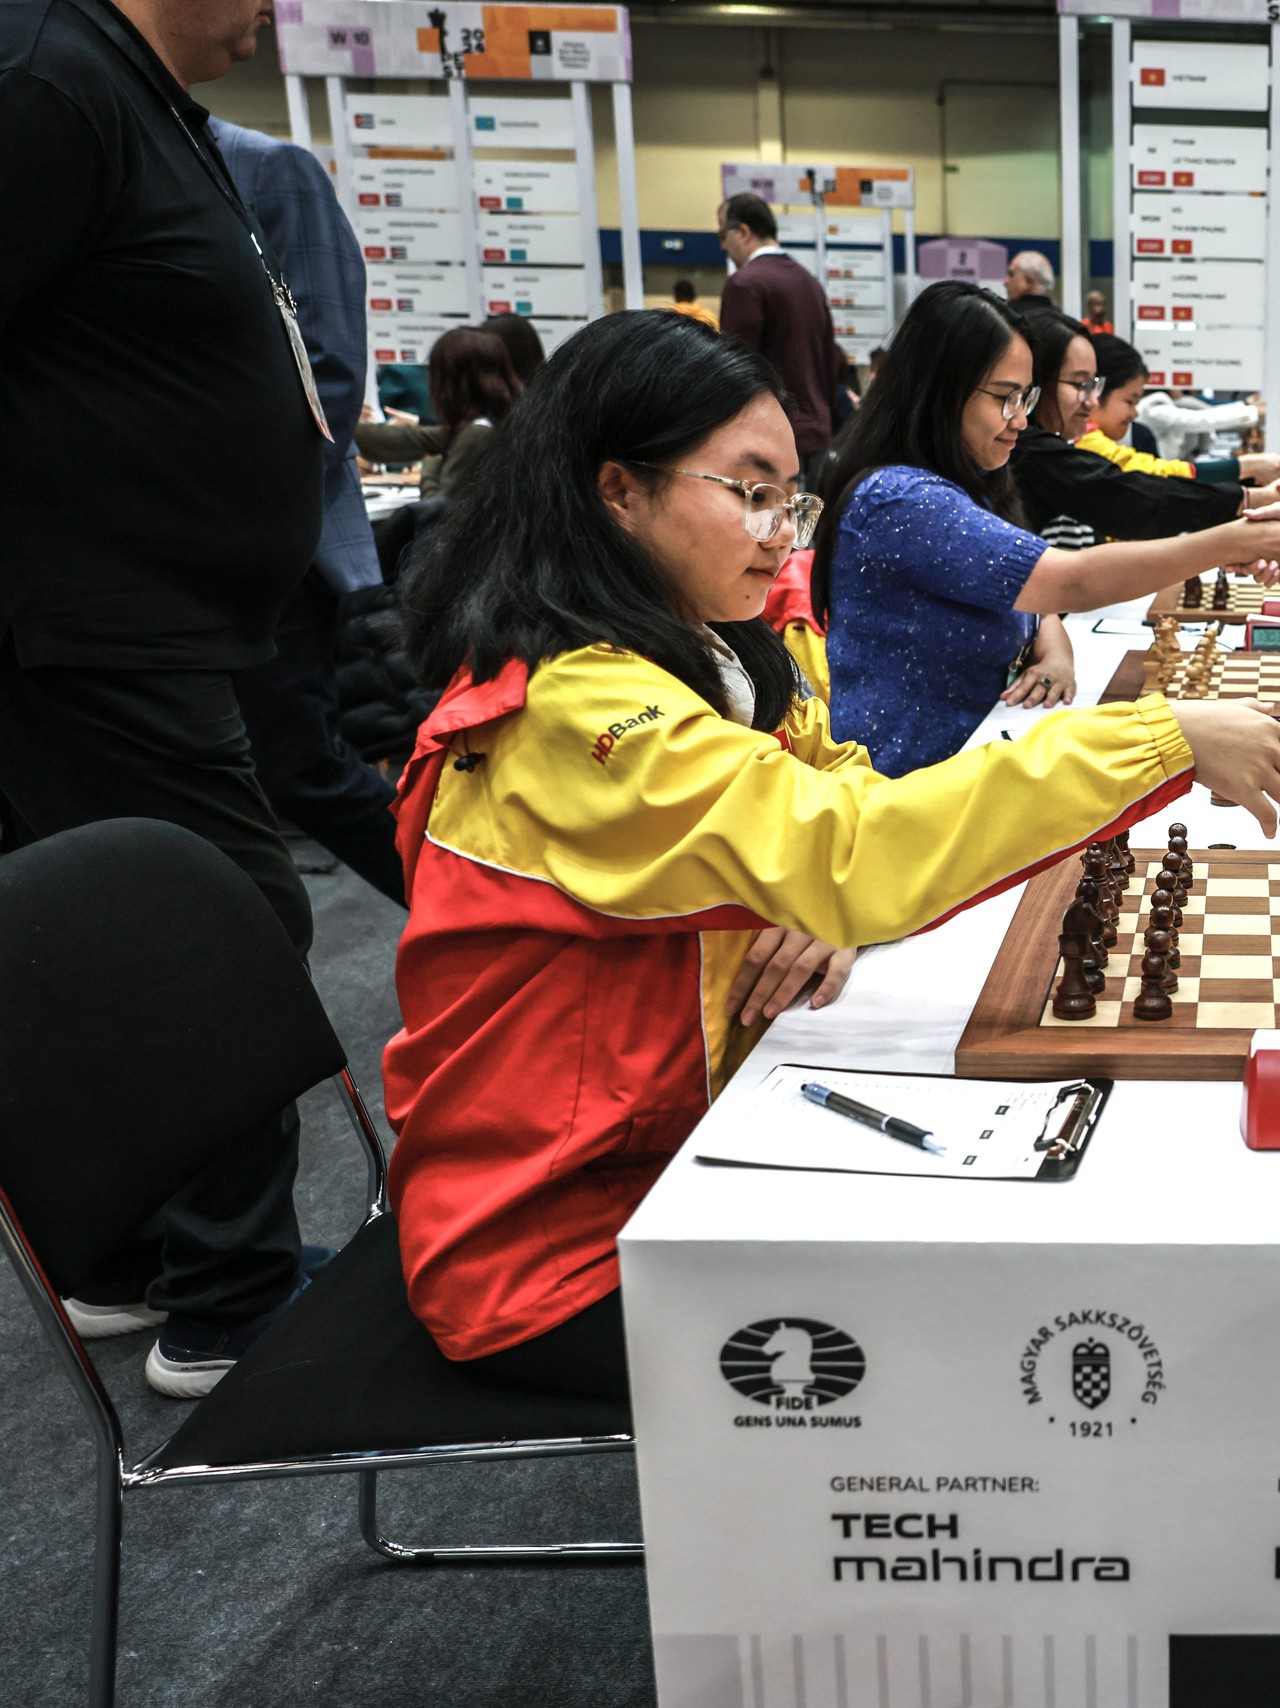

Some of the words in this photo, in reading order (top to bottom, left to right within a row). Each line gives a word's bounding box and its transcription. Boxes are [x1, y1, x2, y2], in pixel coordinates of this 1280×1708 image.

[330, 31, 347, 45] W
[353, 32, 370, 45] 10
[461, 28, 484, 41] 20
[591, 705, 666, 765] HDBank
[1020, 1326, 1055, 1405] MAGYAR
[775, 1397, 814, 1410] FIDE
[734, 1416, 772, 1427] GENS
[775, 1416, 807, 1427] UNA
[810, 1416, 861, 1428] SUMUS
[1070, 1421, 1112, 1437] 1921
[830, 1476, 929, 1492] GENERAL
[936, 1477, 1039, 1493] PARTNER:
[831, 1513, 958, 1539] TECH
[833, 1548, 1130, 1582] mahindra
